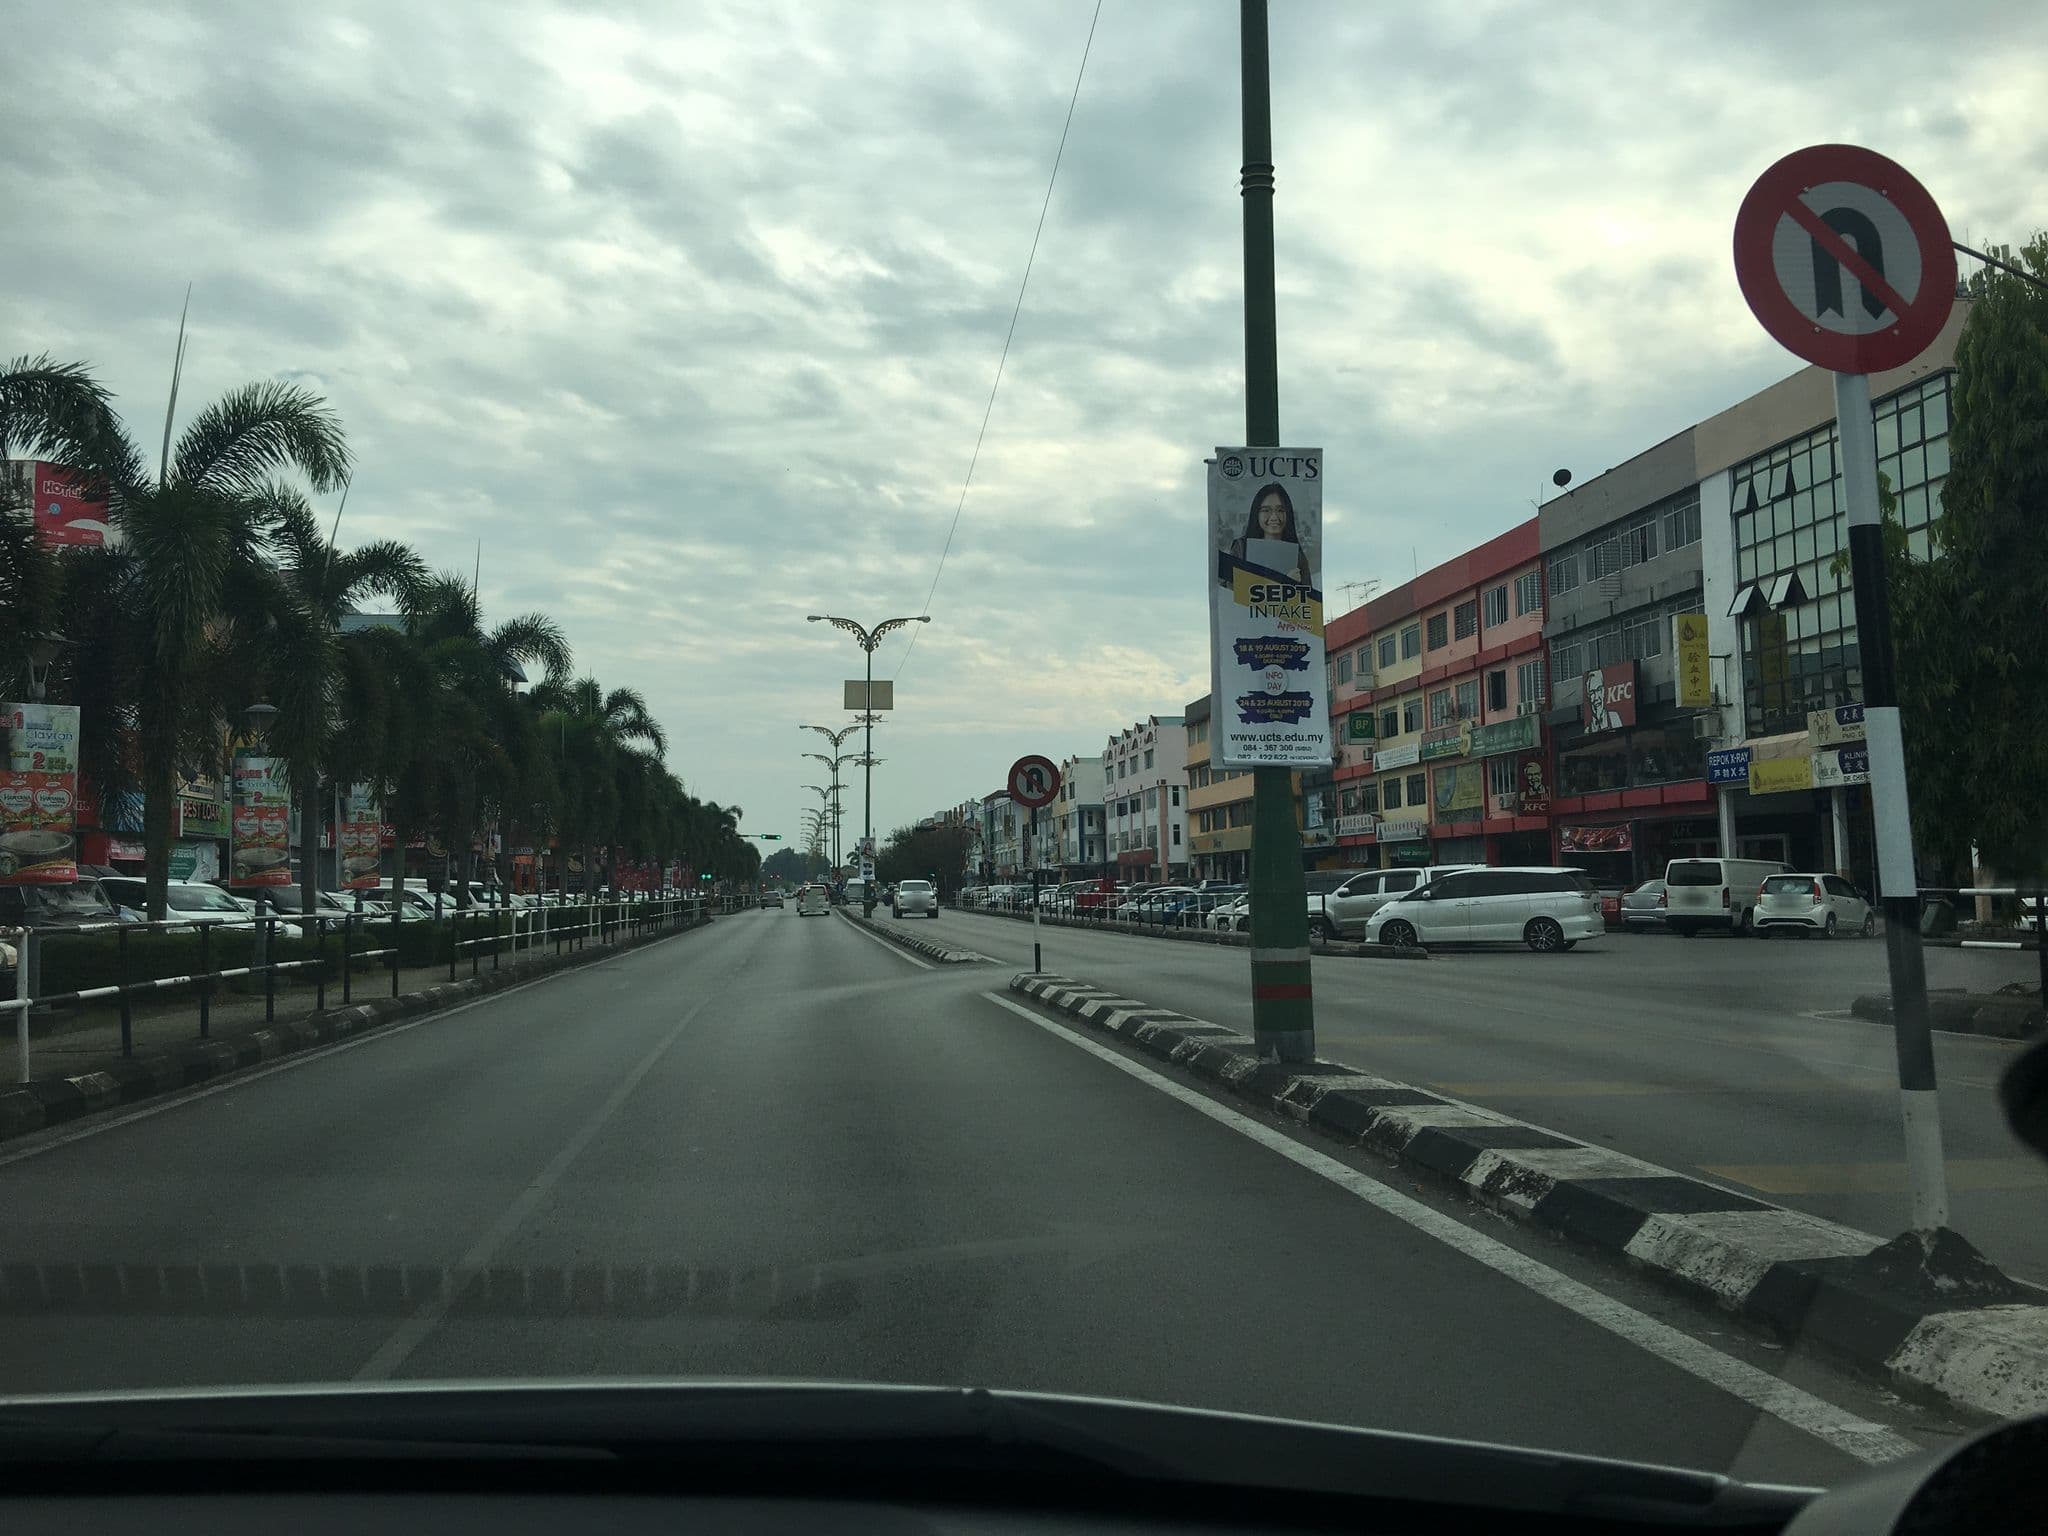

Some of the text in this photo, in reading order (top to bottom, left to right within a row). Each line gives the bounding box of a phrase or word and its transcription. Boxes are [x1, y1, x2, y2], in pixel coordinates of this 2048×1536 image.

[1249, 457, 1318, 478] UCTS
[1249, 584, 1311, 604] SEPT
[1249, 604, 1312, 619] INTAKE
[1265, 671, 1283, 680] INFO
[1267, 682, 1281, 691] DAY
[1606, 681, 1633, 705] KFC
[1355, 719, 1369, 731] BP
[1230, 733, 1324, 744] www.ucts.edu.my
[1730, 751, 1749, 764] X-RAY
[183, 799, 202, 819] BEST
[1524, 802, 1548, 811] KFC
